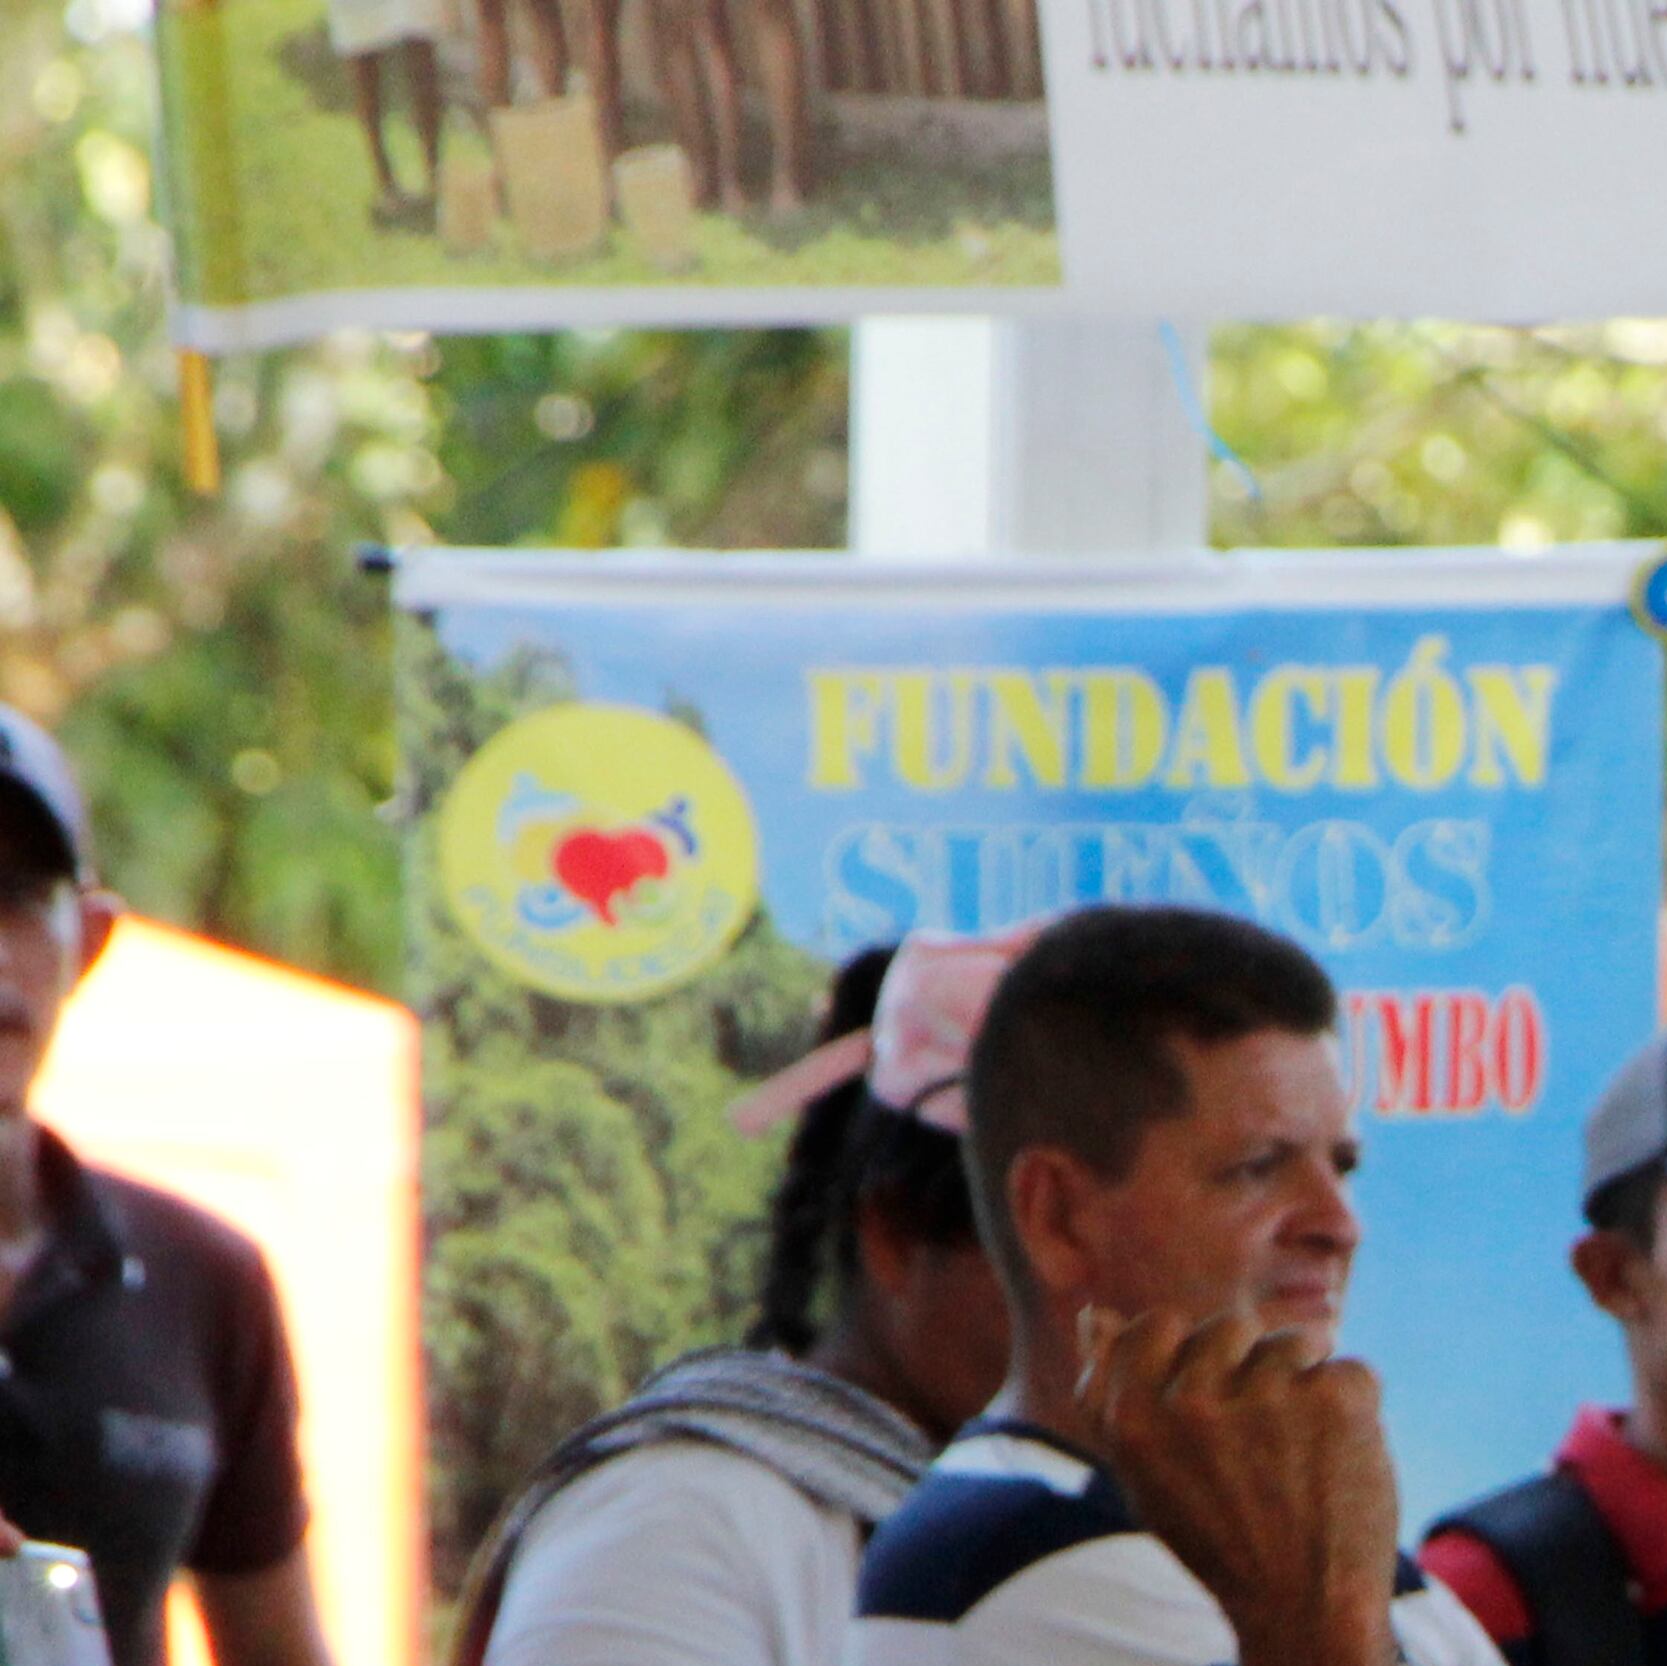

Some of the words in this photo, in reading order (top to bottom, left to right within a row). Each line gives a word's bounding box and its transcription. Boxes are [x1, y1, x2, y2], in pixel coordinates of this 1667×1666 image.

[1432, 0, 1537, 134] por
[808, 634, 1556, 790] FUNDACIÓN
[822, 792, 1494, 952] SUEÑOS
